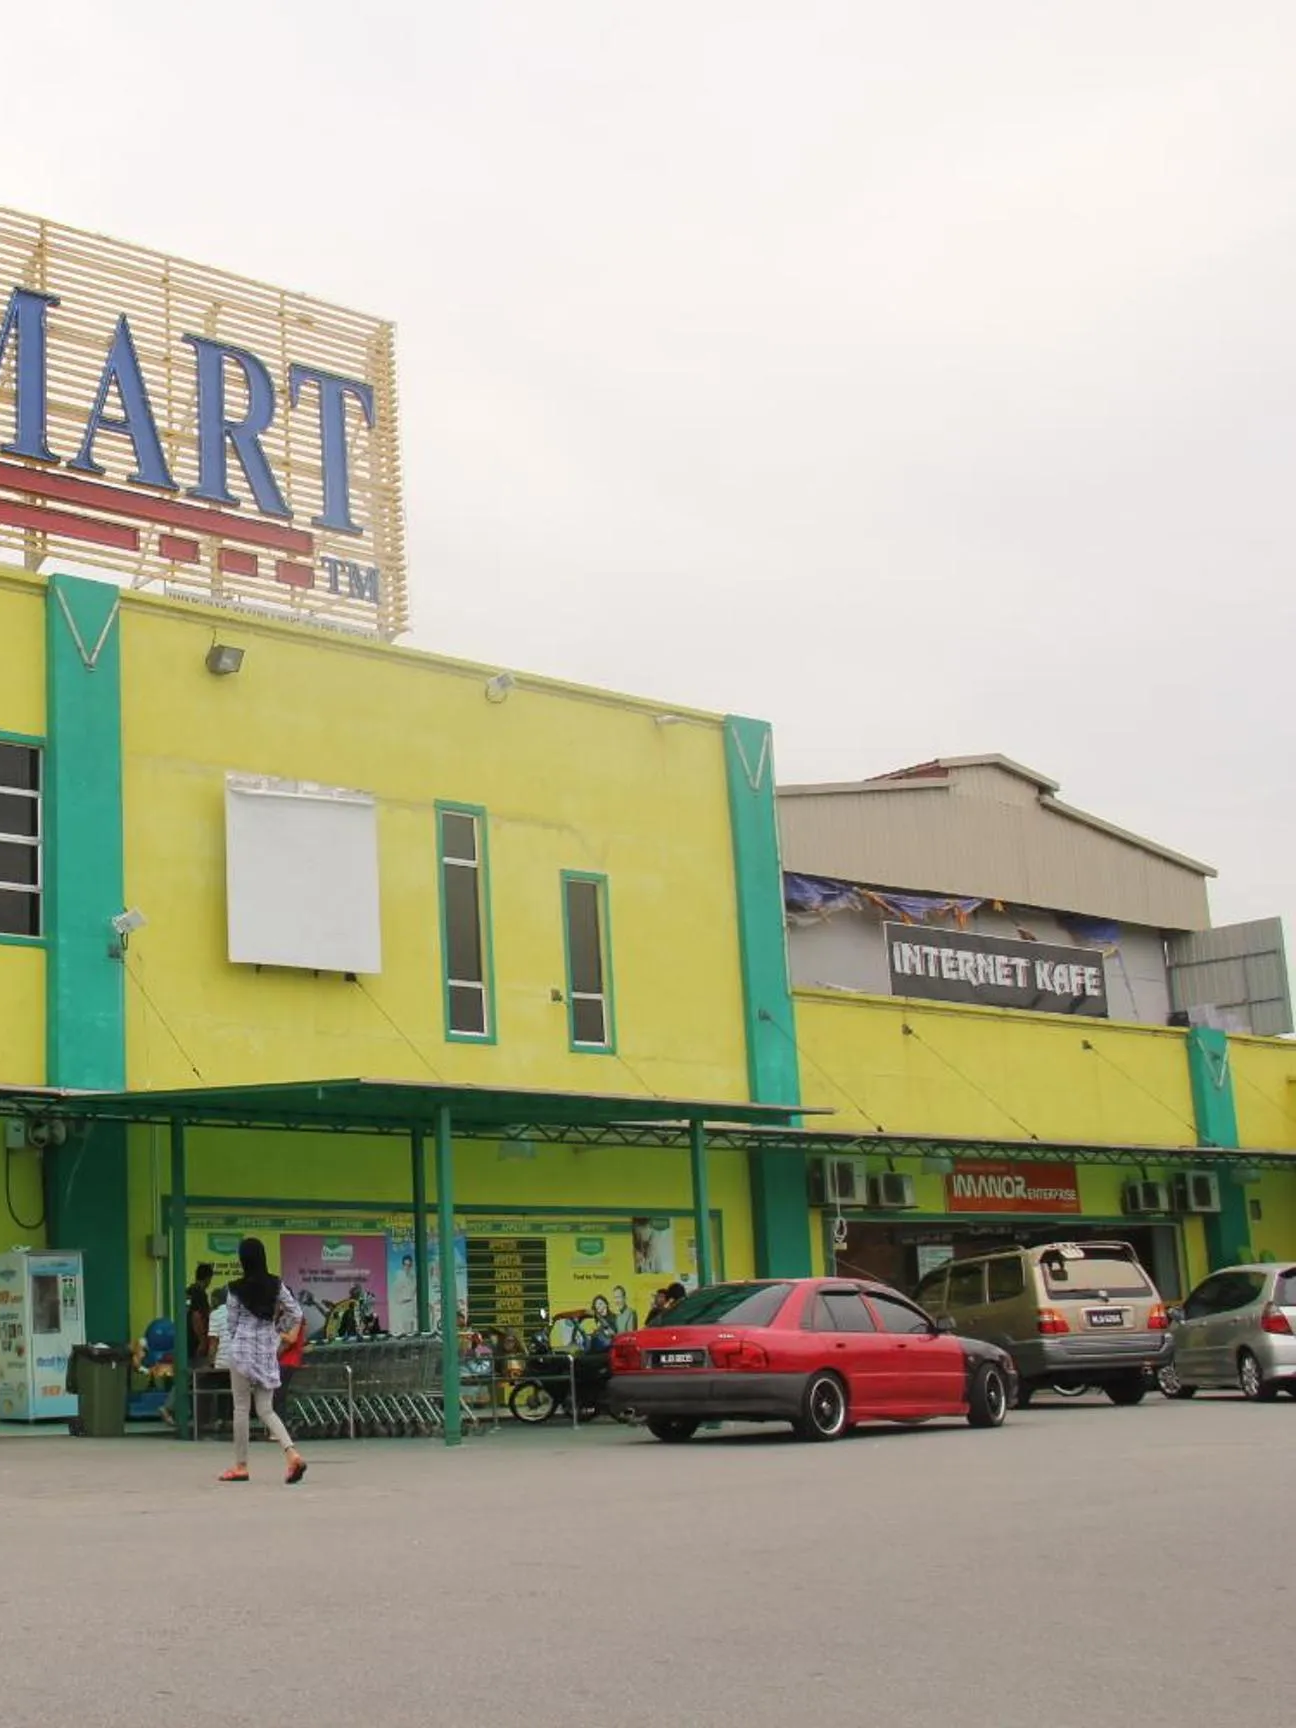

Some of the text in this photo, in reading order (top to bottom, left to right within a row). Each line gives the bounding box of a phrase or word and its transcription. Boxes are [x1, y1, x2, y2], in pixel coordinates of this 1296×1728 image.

[321, 554, 380, 604] TM
[892, 940, 1102, 997] INTERNET KAFE
